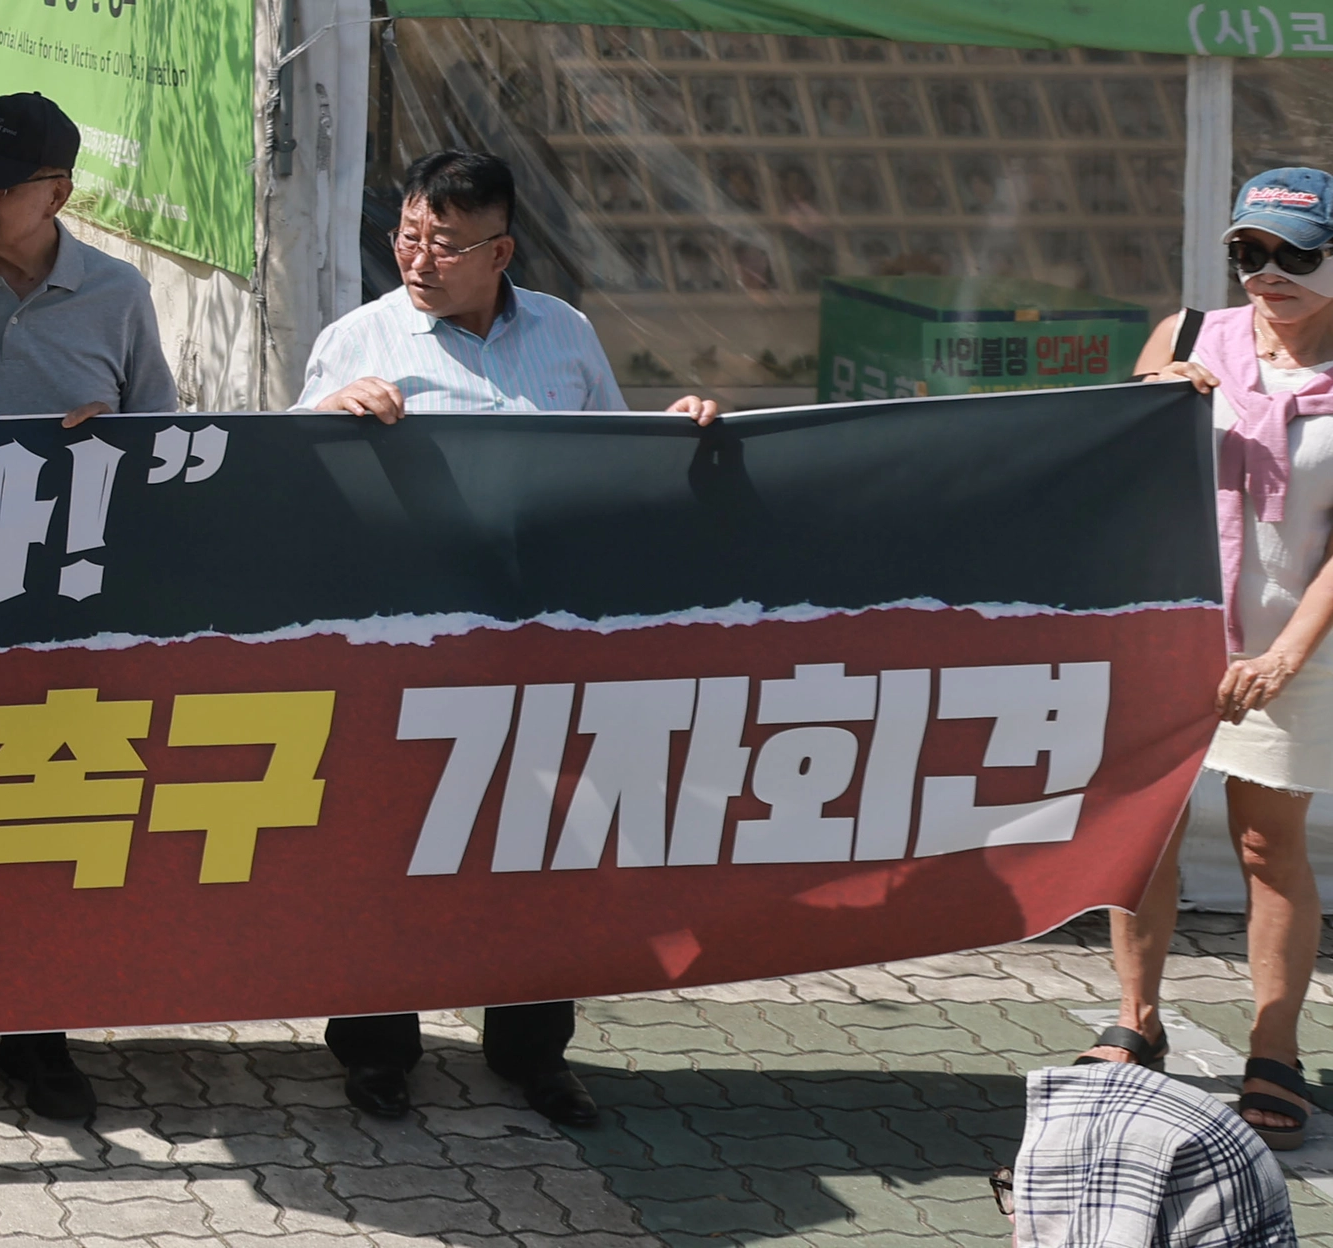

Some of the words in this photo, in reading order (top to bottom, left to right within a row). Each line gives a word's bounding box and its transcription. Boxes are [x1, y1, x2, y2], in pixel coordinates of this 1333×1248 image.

[17, 32, 37, 55] Altar
[39, 37, 53, 60] for
[54, 40, 68, 64] the
[100, 51, 112, 73] of
[933, 336, 1029, 378] 사인불명
[1036, 334, 1110, 376] 인과성
[397, 661, 1111, 876] 기자회견
